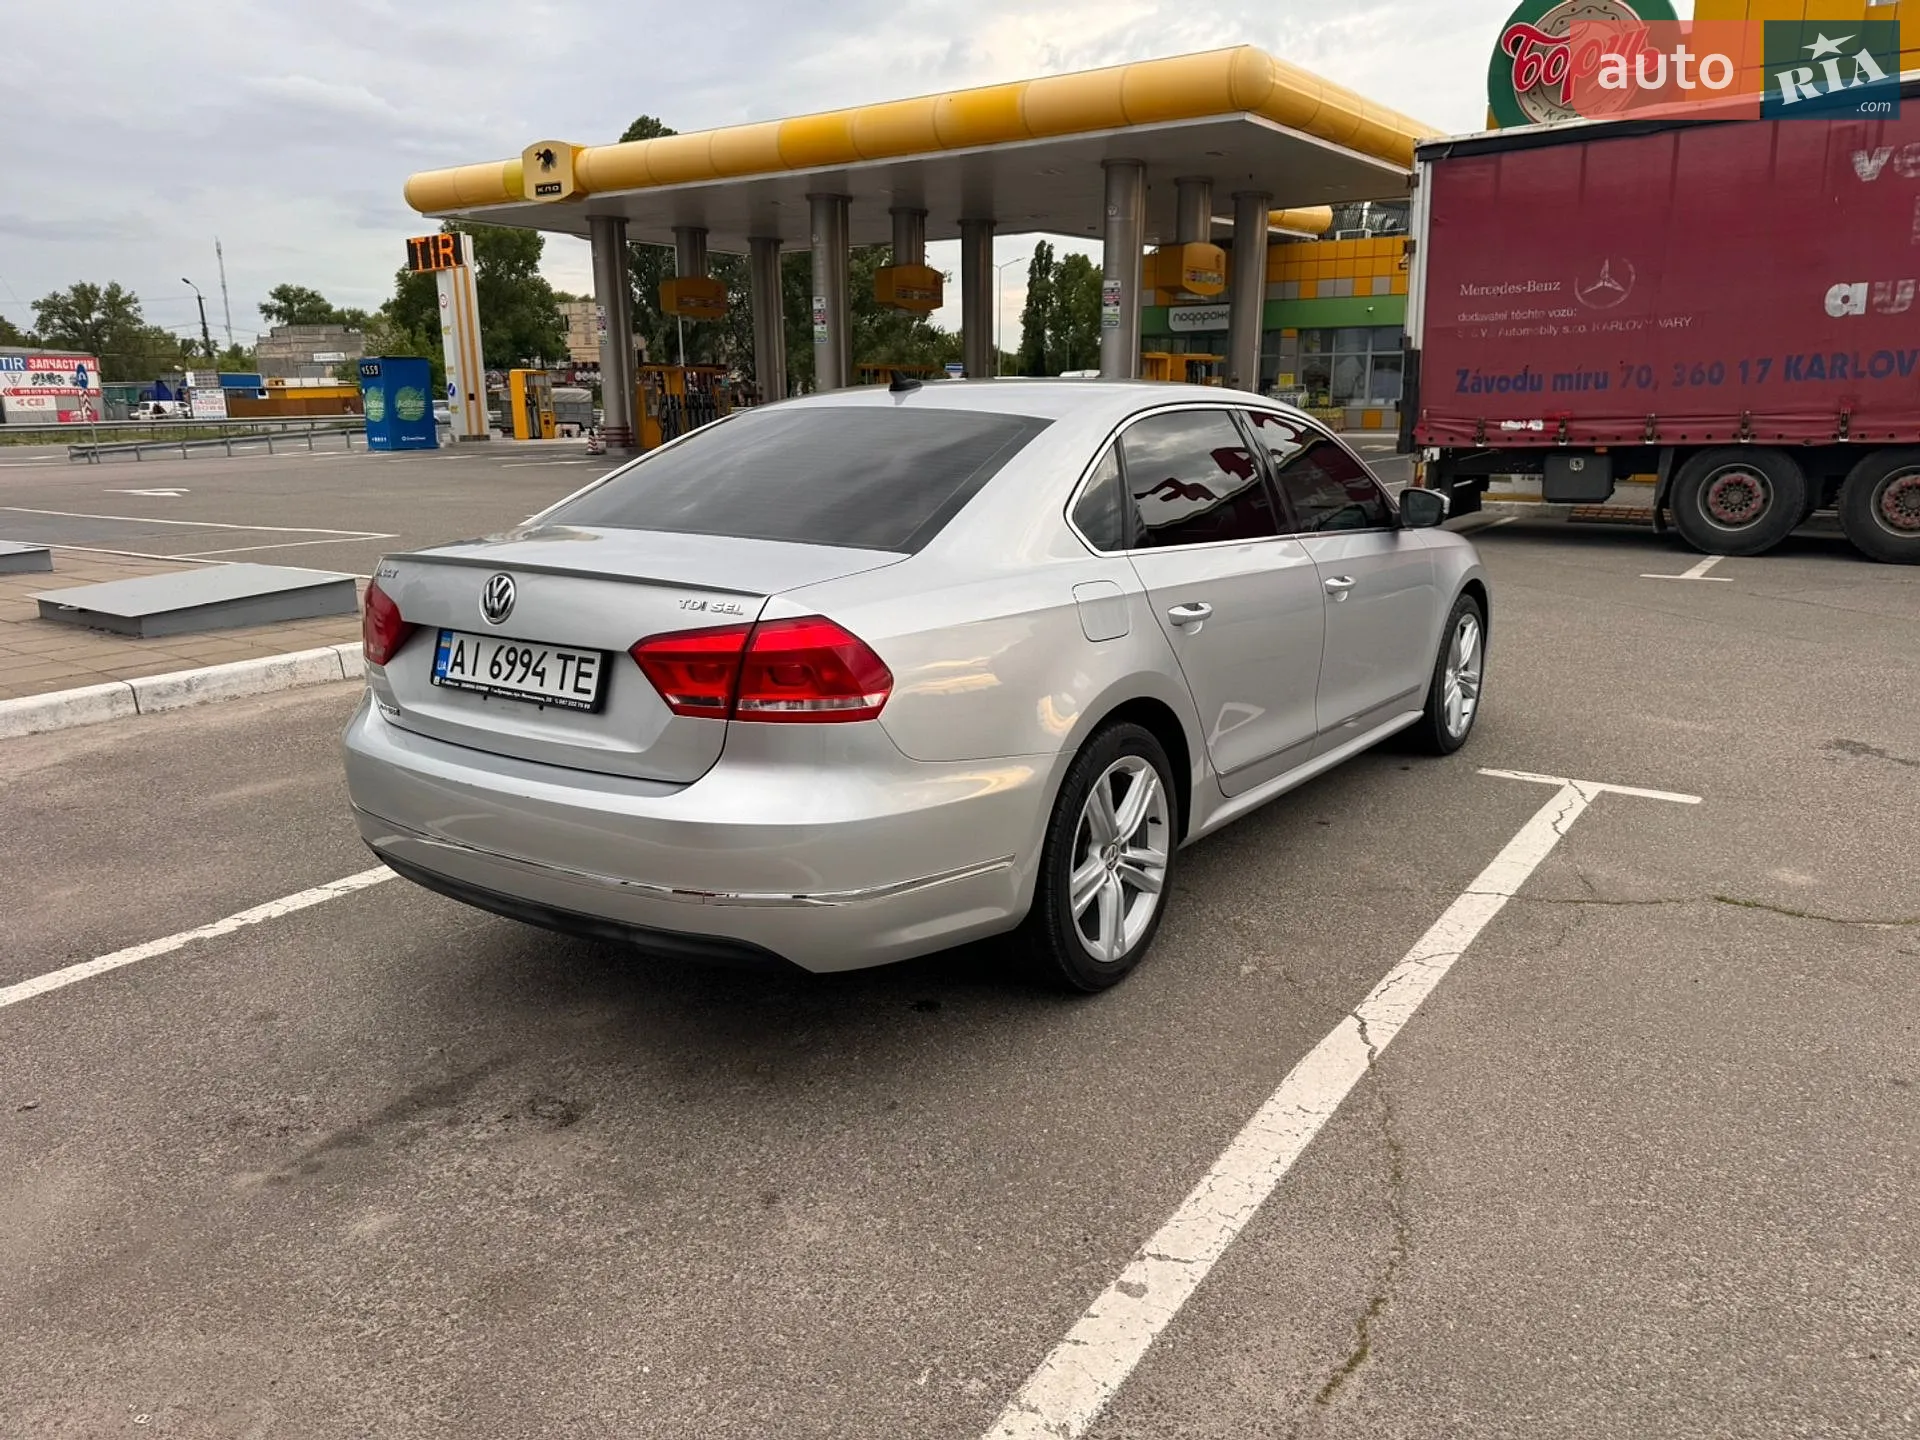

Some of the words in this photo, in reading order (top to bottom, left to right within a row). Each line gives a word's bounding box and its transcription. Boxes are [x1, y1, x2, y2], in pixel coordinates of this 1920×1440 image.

[410, 233, 457, 272] TIR
[1459, 280, 1561, 297] Mercedes-Benz
[1824, 279, 1920, 318] au
[0, 357, 25, 370] TIR
[1455, 365, 1544, 394] Závodu
[1552, 363, 1609, 392] míru
[1671, 359, 1726, 388] 360
[1738, 356, 1773, 385] 17
[679, 598, 708, 612] TDI
[450, 639, 480, 677] AI
[489, 644, 548, 688] 6994
[556, 652, 596, 695] TE
